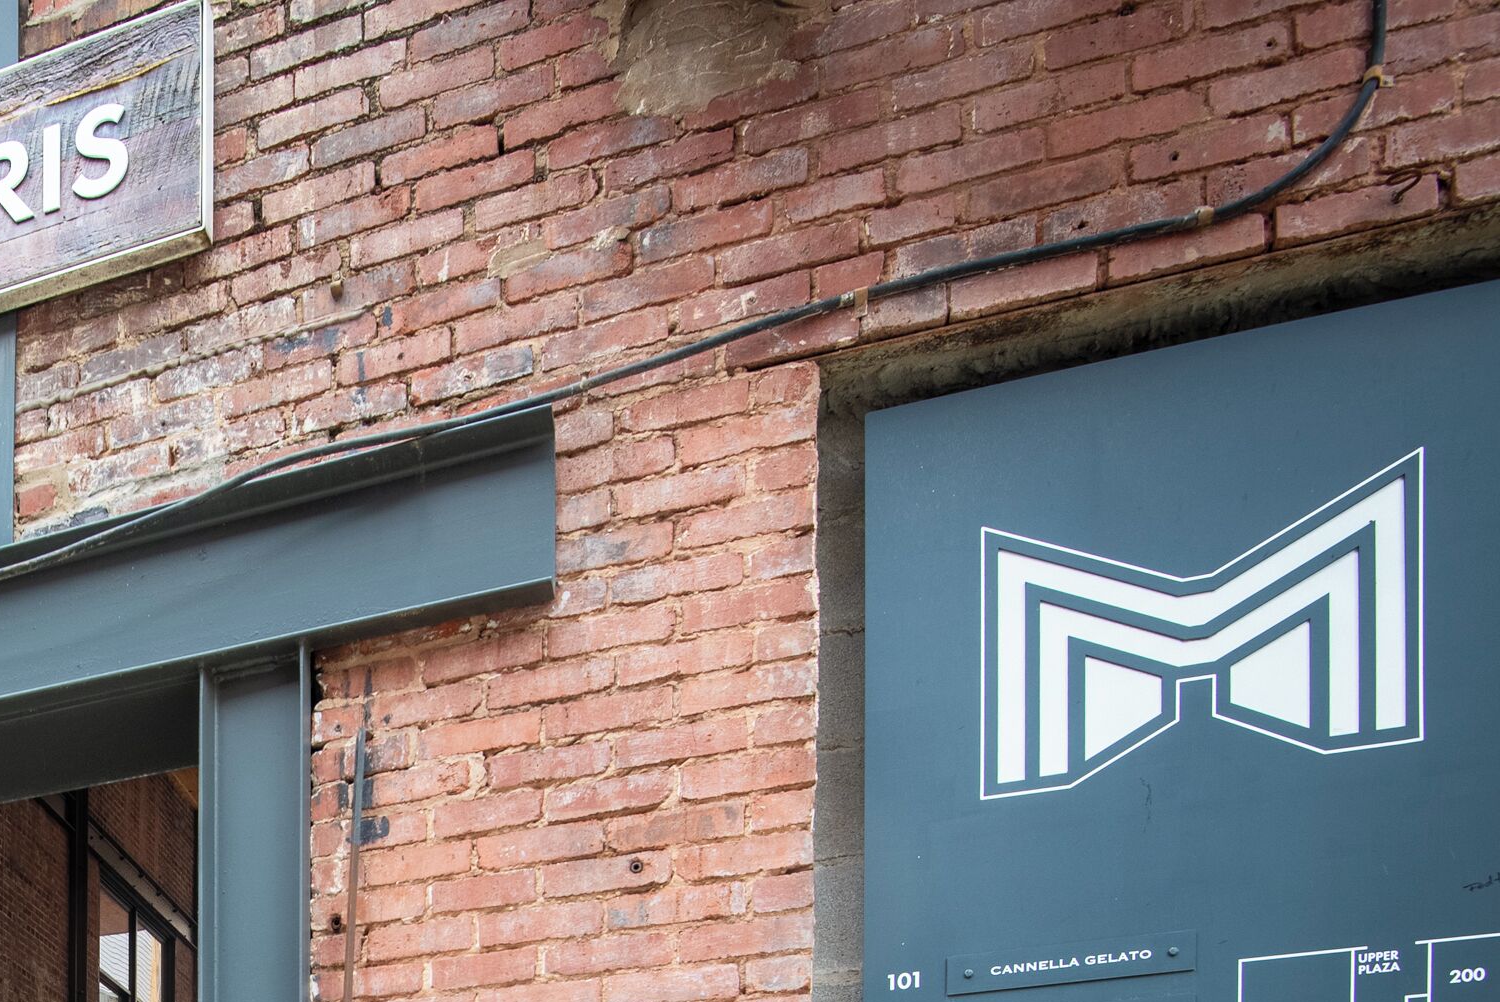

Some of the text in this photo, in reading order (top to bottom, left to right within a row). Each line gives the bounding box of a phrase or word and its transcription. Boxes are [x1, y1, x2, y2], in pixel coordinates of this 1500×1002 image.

[1358, 950, 1399, 963] UPPER
[887, 949, 1152, 990] 101 CANNELLA GELATO
[1358, 961, 1401, 975] PLAZA
[1449, 967, 1486, 984] 200
